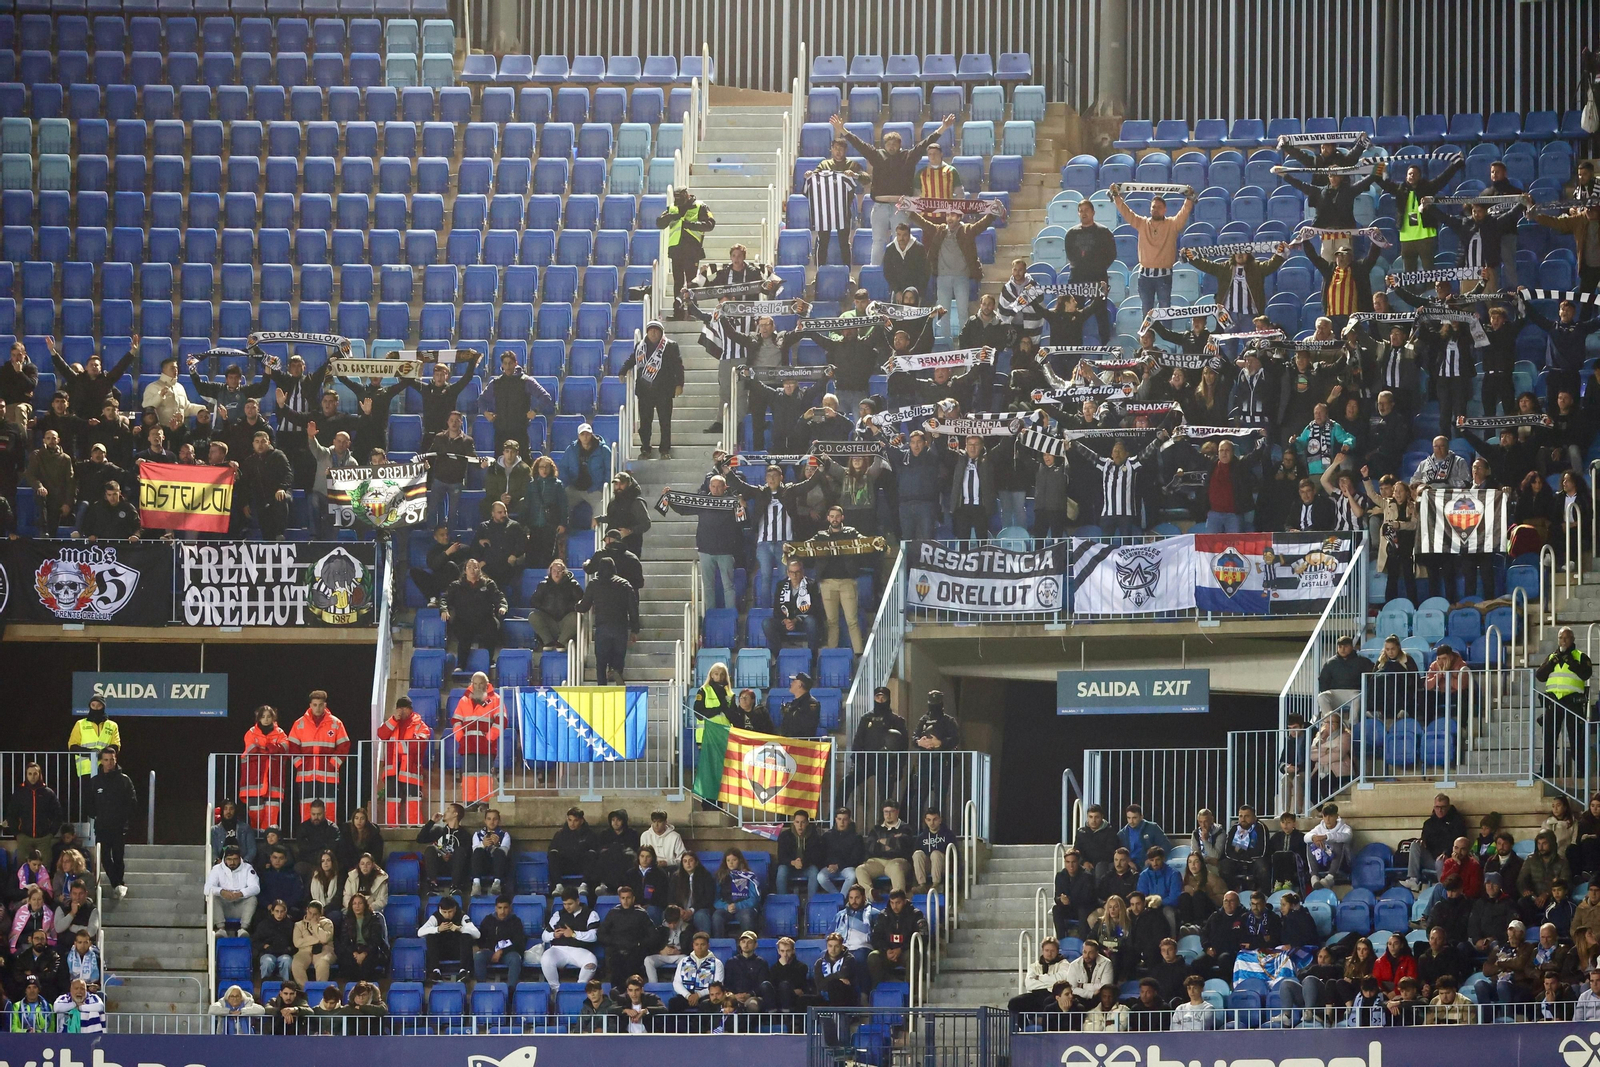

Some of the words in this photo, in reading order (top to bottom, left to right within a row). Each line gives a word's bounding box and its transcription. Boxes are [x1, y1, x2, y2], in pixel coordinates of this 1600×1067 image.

[917, 353, 969, 364] RENAIXEM
[1158, 358, 1208, 368] LBINEGRA
[330, 467, 373, 483] FRENTE
[378, 464, 426, 479] ORELLUT
[179, 544, 298, 588] FRENTE
[936, 581, 1031, 605] ORELLUT
[184, 585, 310, 626] ORELLUT
[55, 610, 81, 619] FRENTE
[82, 612, 113, 621] ORELLUT
[332, 614, 351, 624] 1987
[94, 683, 158, 698] SALIDA
[170, 684, 210, 699] EXIT
[1077, 681, 1140, 697] SALIDA
[1153, 680, 1191, 696] EXIT
